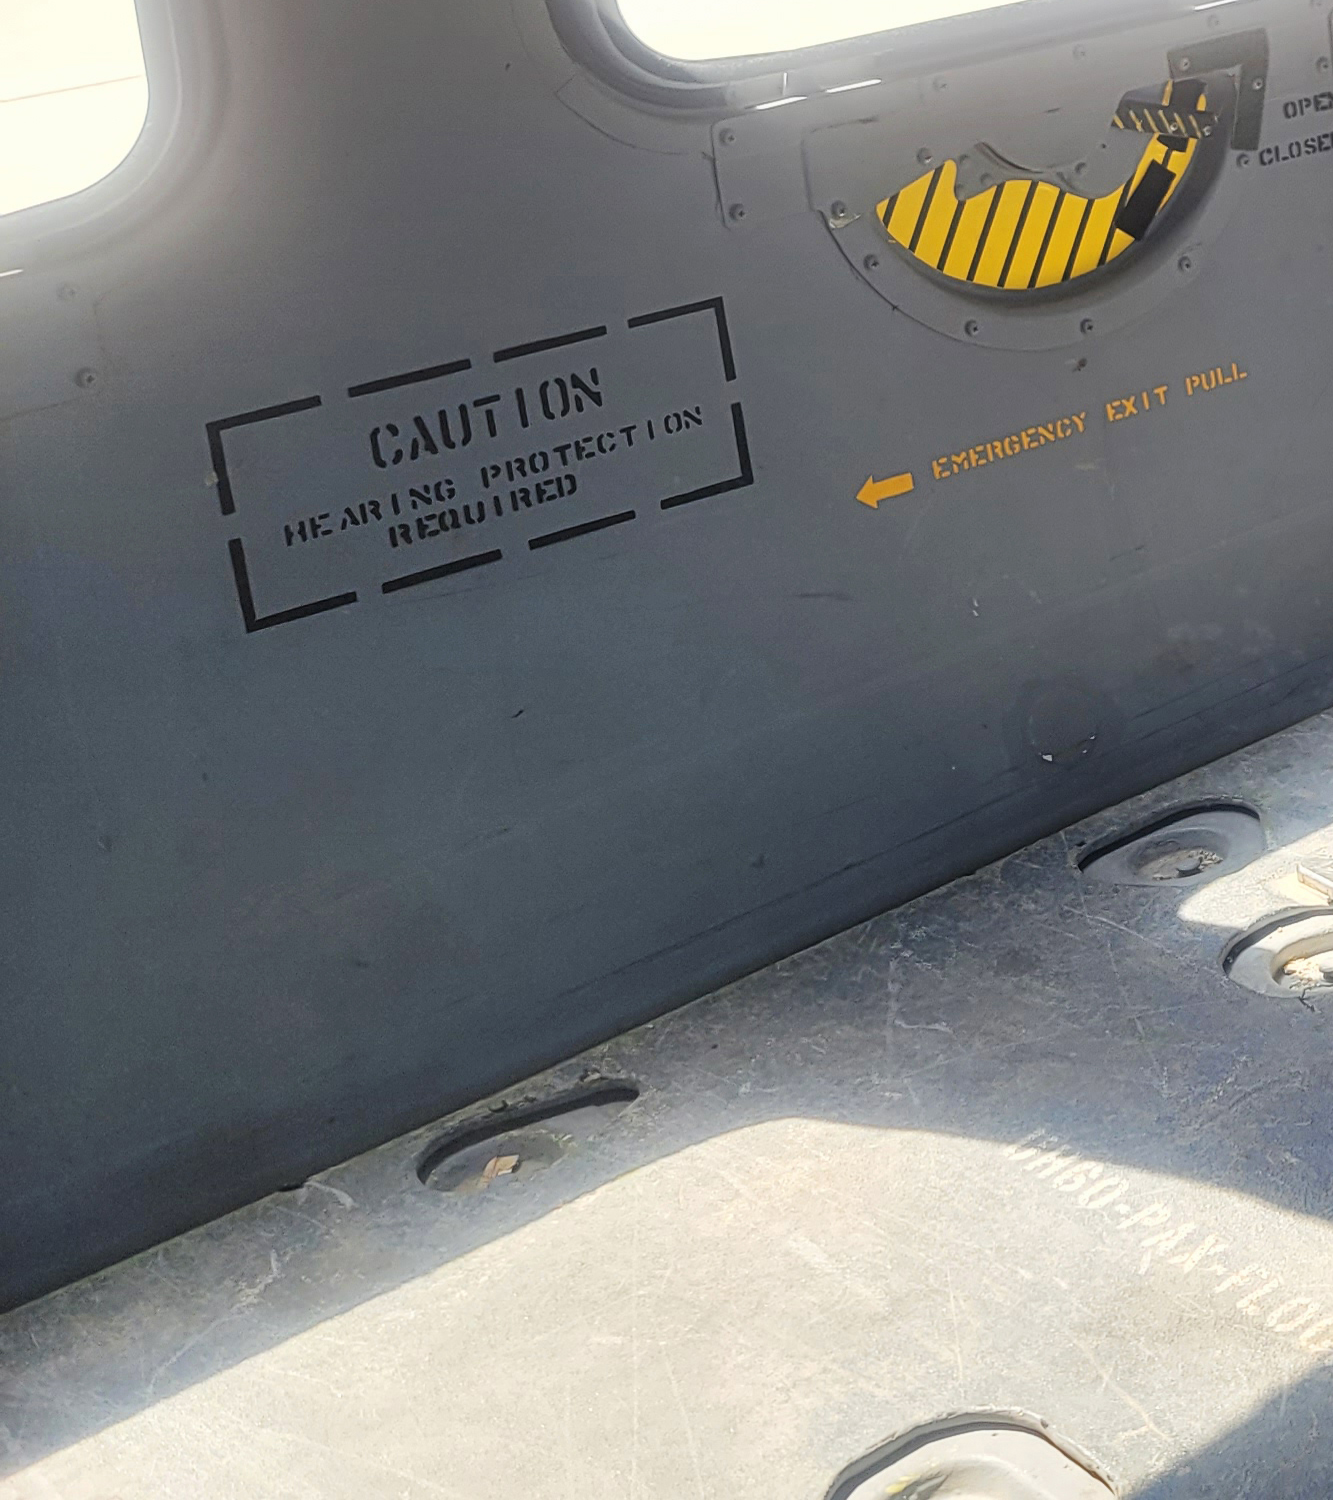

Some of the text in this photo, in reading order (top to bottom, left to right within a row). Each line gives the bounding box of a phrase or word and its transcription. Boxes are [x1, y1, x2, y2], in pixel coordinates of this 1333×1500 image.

[369, 367, 603, 469] CAUTION
[931, 362, 1248, 481] EMERGENCY EXIT PULL
[283, 406, 704, 547] HEARING PROTECTION
[389, 472, 578, 548] REQUIRED
